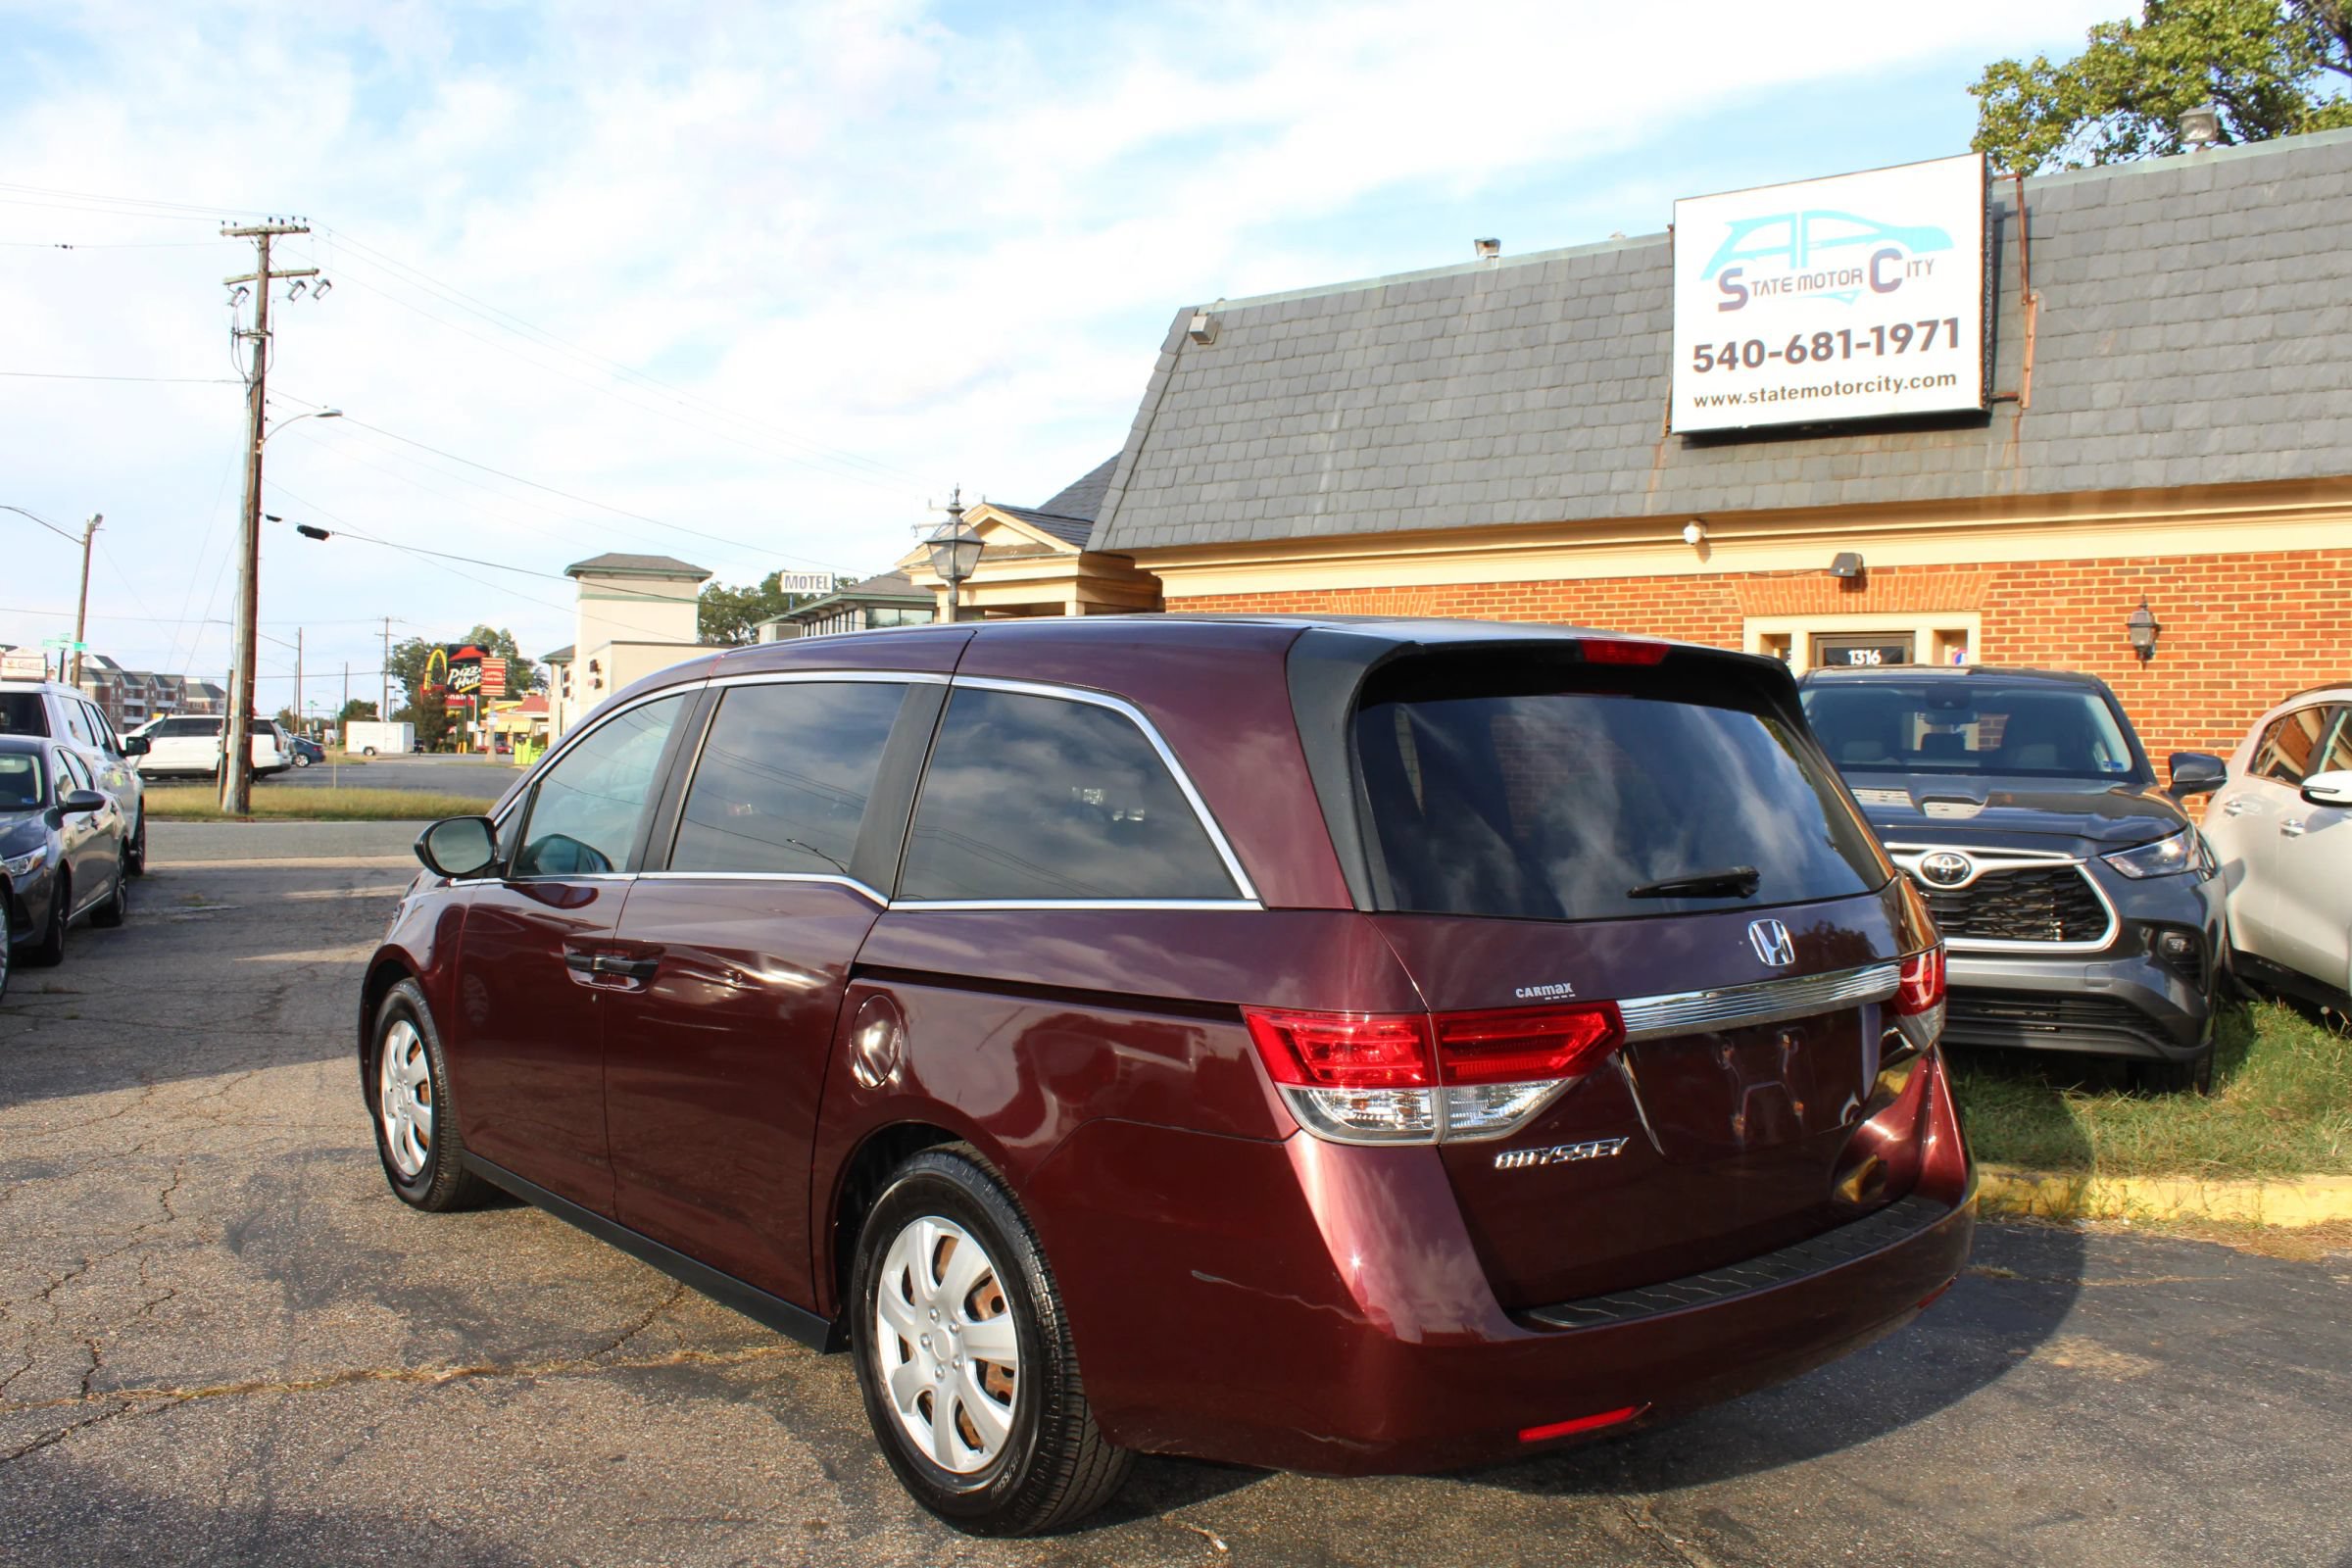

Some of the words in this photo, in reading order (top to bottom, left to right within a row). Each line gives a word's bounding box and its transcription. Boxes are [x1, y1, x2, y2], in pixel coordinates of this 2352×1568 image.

[1718, 268, 1793, 313] STATE
[1797, 268, 1863, 291] MOTOR
[1869, 248, 1935, 293] CITY
[1692, 318, 1959, 373] 540-681-1971
[1693, 373, 1957, 408] www.statemotorcity.com
[784, 575, 830, 590] MOTEL
[1848, 650, 1882, 665] 1316
[455, 675, 481, 690] Hut
[1494, 1137, 1630, 1169] ODYSSEY
